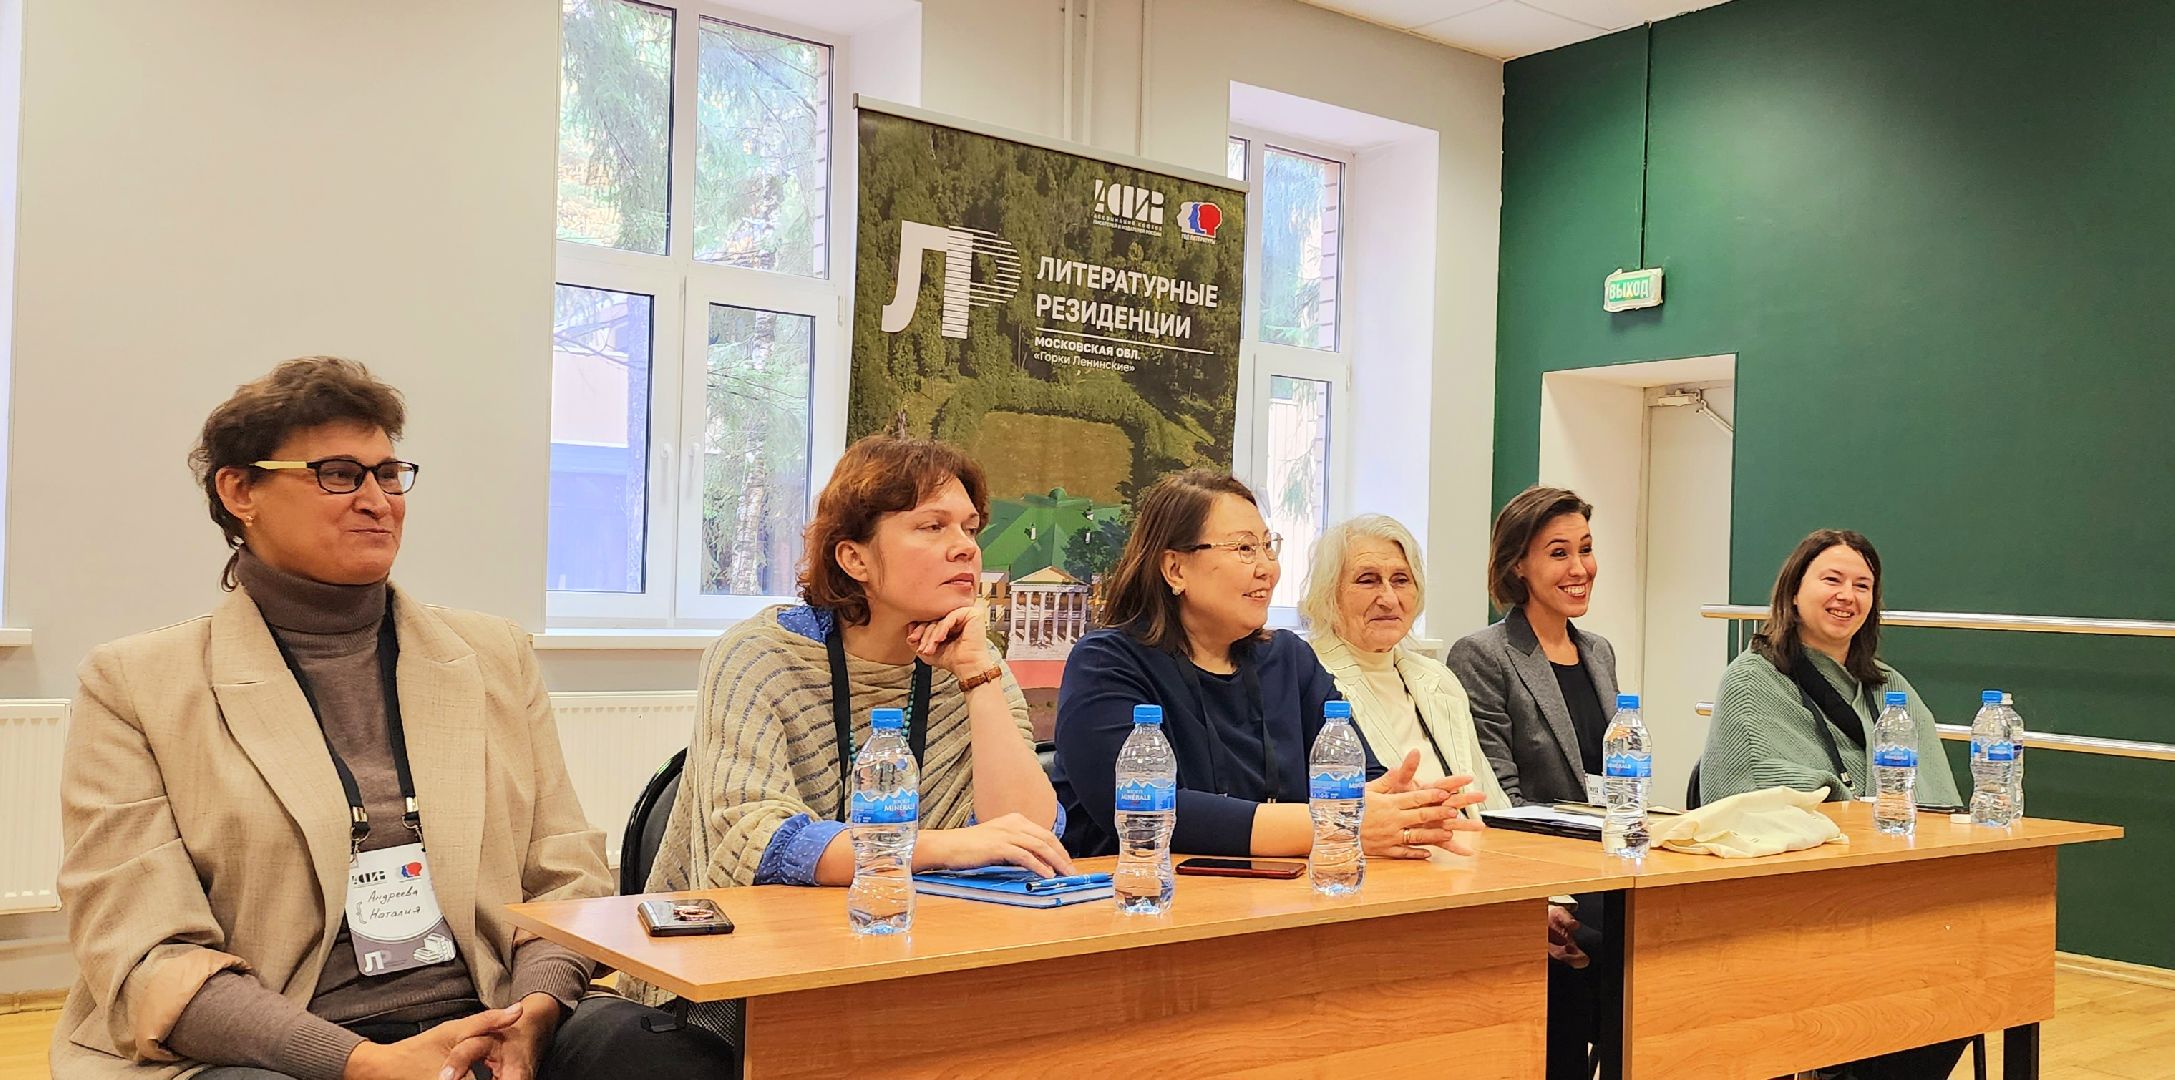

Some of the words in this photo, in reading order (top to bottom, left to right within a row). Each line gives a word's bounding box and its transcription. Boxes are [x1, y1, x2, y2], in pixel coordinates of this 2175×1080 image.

[1036, 255, 1219, 309] ЛИТЕРАТУРНЫЕ
[1609, 279, 1649, 299] ВЫХОД
[1035, 293, 1191, 340] РЕЗИДЕНЦИИ
[1034, 336, 1114, 357] МОСКОВСКАЯ
[1115, 348, 1142, 361] ОБЛ.
[1033, 350, 1071, 366] «Горки
[1071, 354, 1136, 373] Ленинские»
